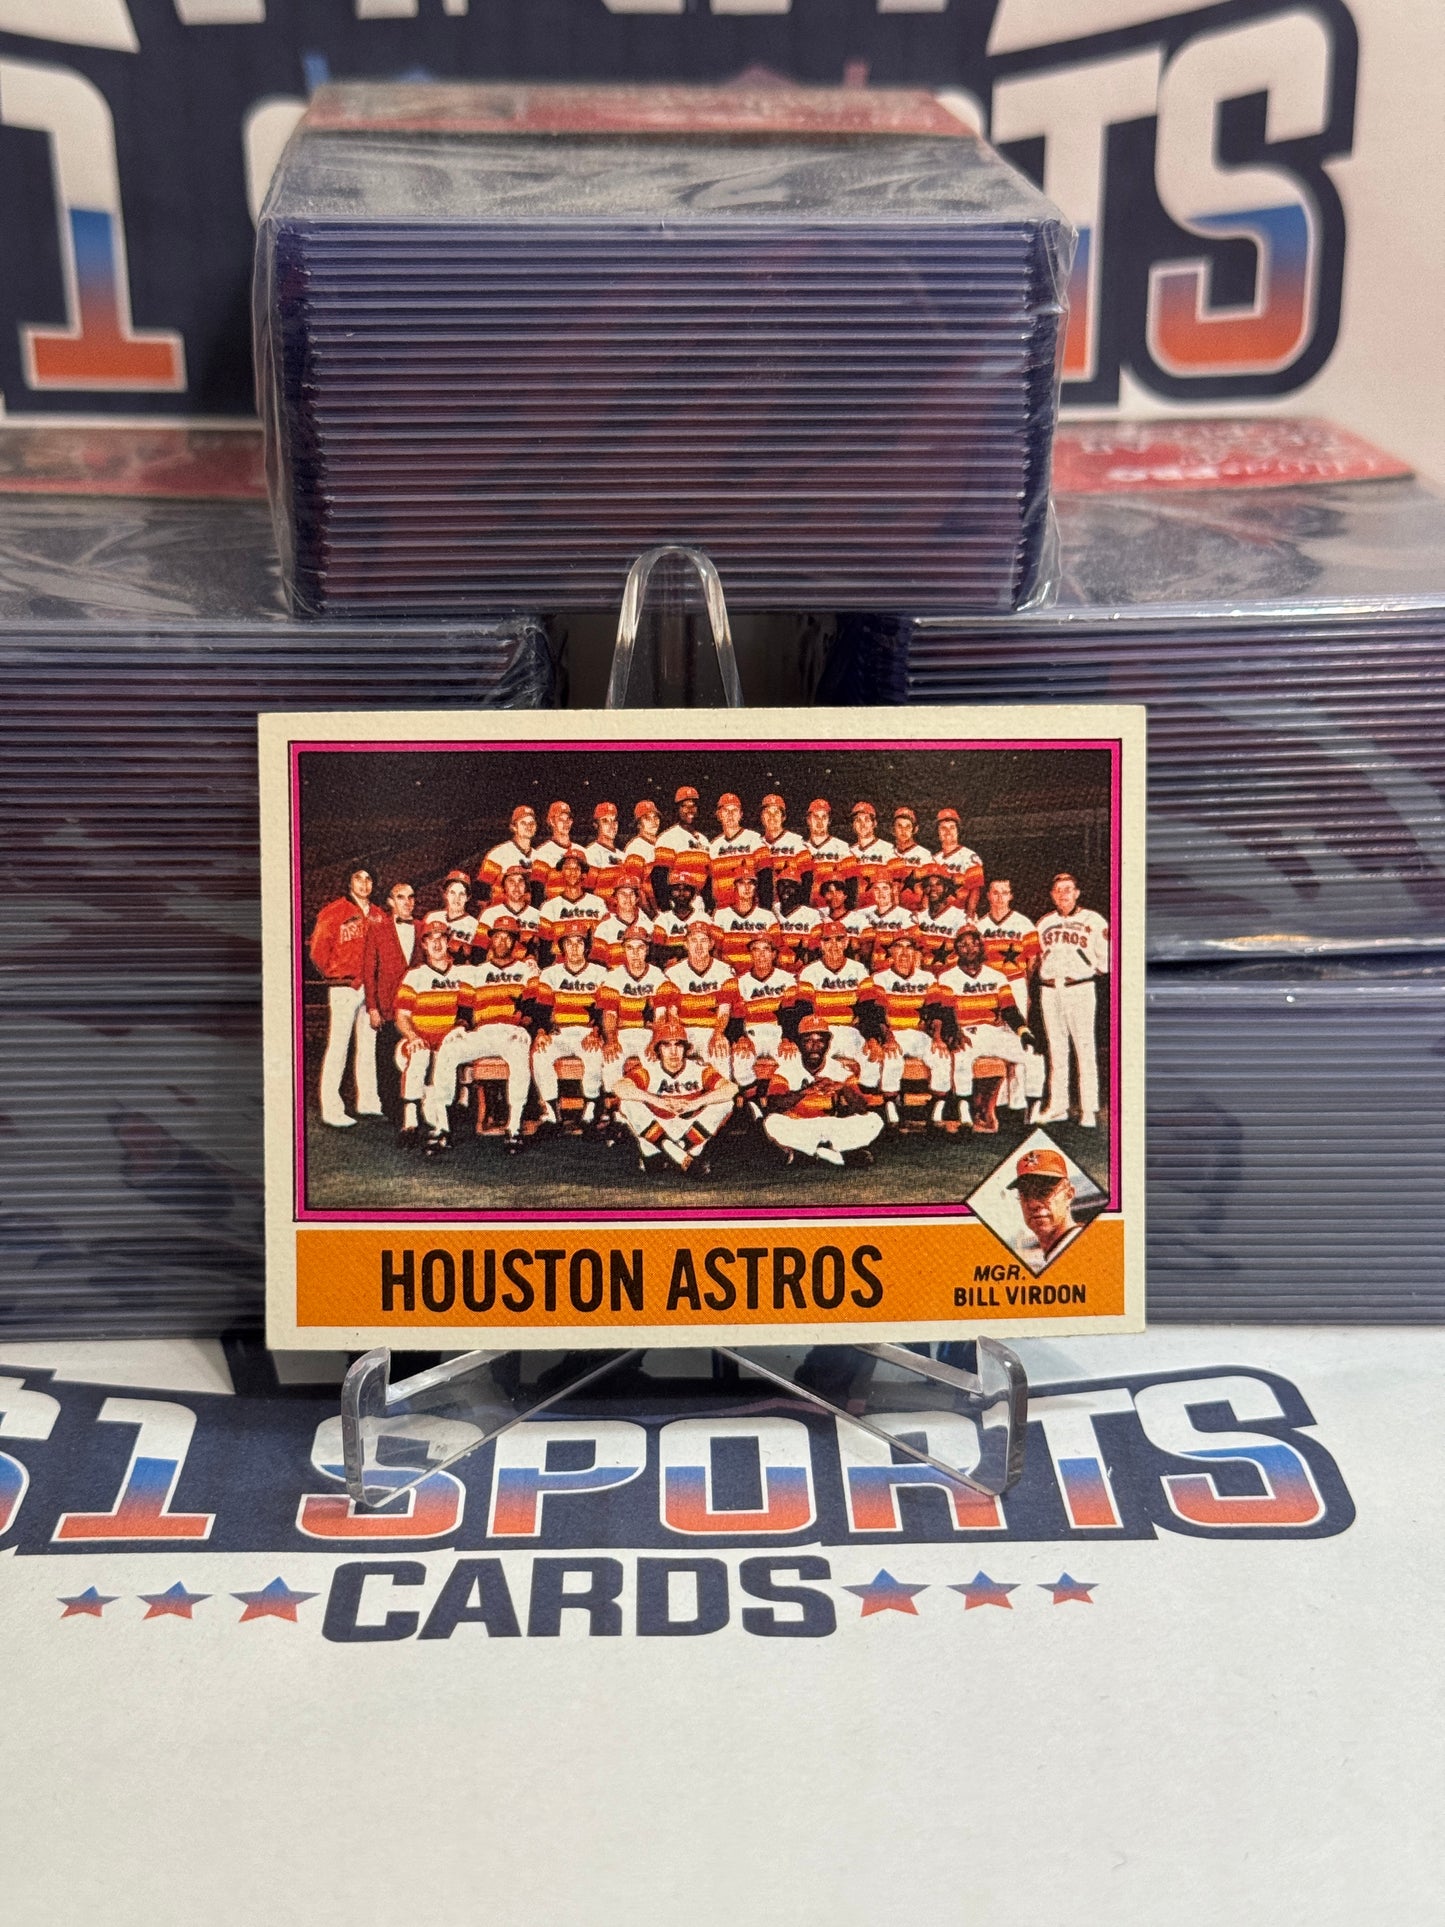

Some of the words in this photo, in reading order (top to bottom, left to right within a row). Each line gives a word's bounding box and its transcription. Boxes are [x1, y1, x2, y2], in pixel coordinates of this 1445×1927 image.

[380, 1247, 645, 1314] HOUSTON
[665, 1244, 884, 1312] ASTROS
[953, 1285, 1000, 1308] BILL
[1005, 1283, 1087, 1306] VIRDON
[973, 1264, 1027, 1282] MGR.
[295, 1375, 1327, 1540] SPORTS
[321, 1554, 838, 1643] CARDS
